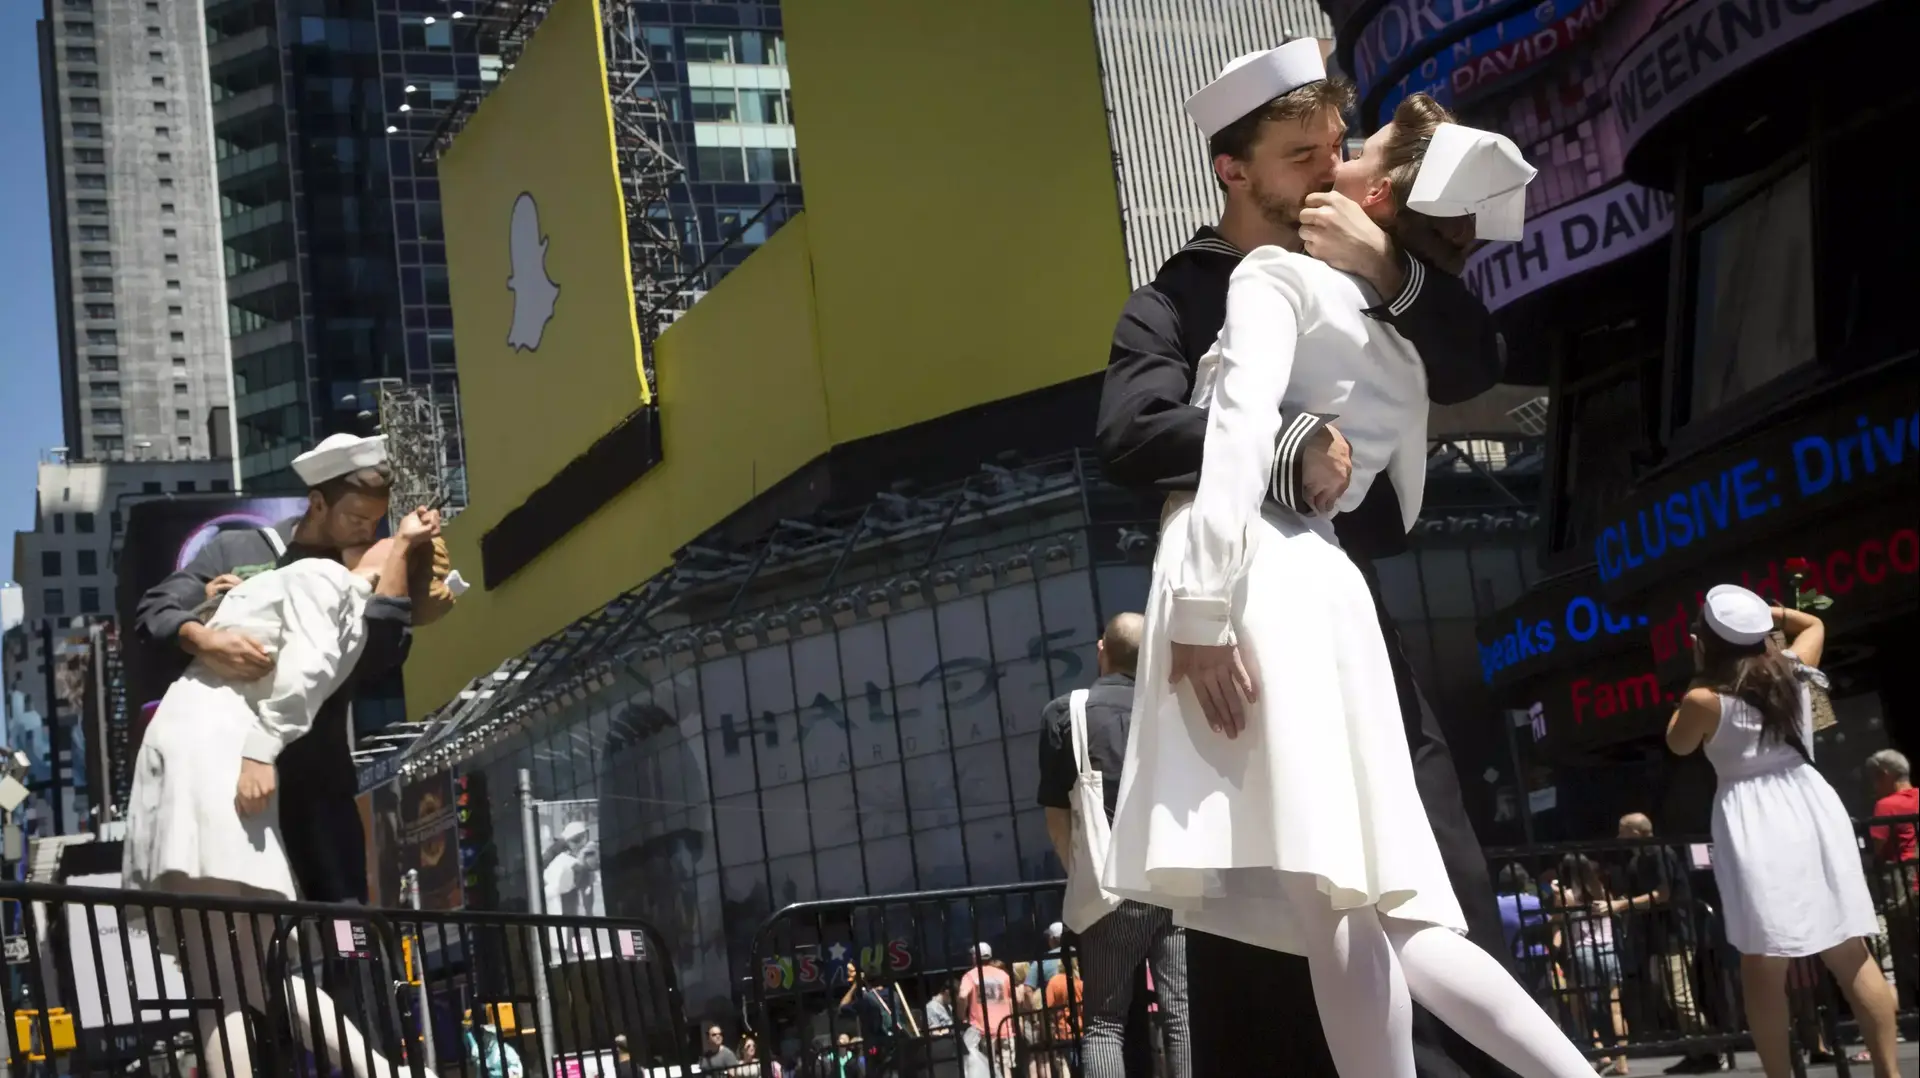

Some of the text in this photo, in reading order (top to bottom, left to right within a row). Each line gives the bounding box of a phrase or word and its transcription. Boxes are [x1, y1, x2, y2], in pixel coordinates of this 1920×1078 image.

[1452, 28, 1558, 93] DAVID
[720, 628, 1083, 757] HALO 5
